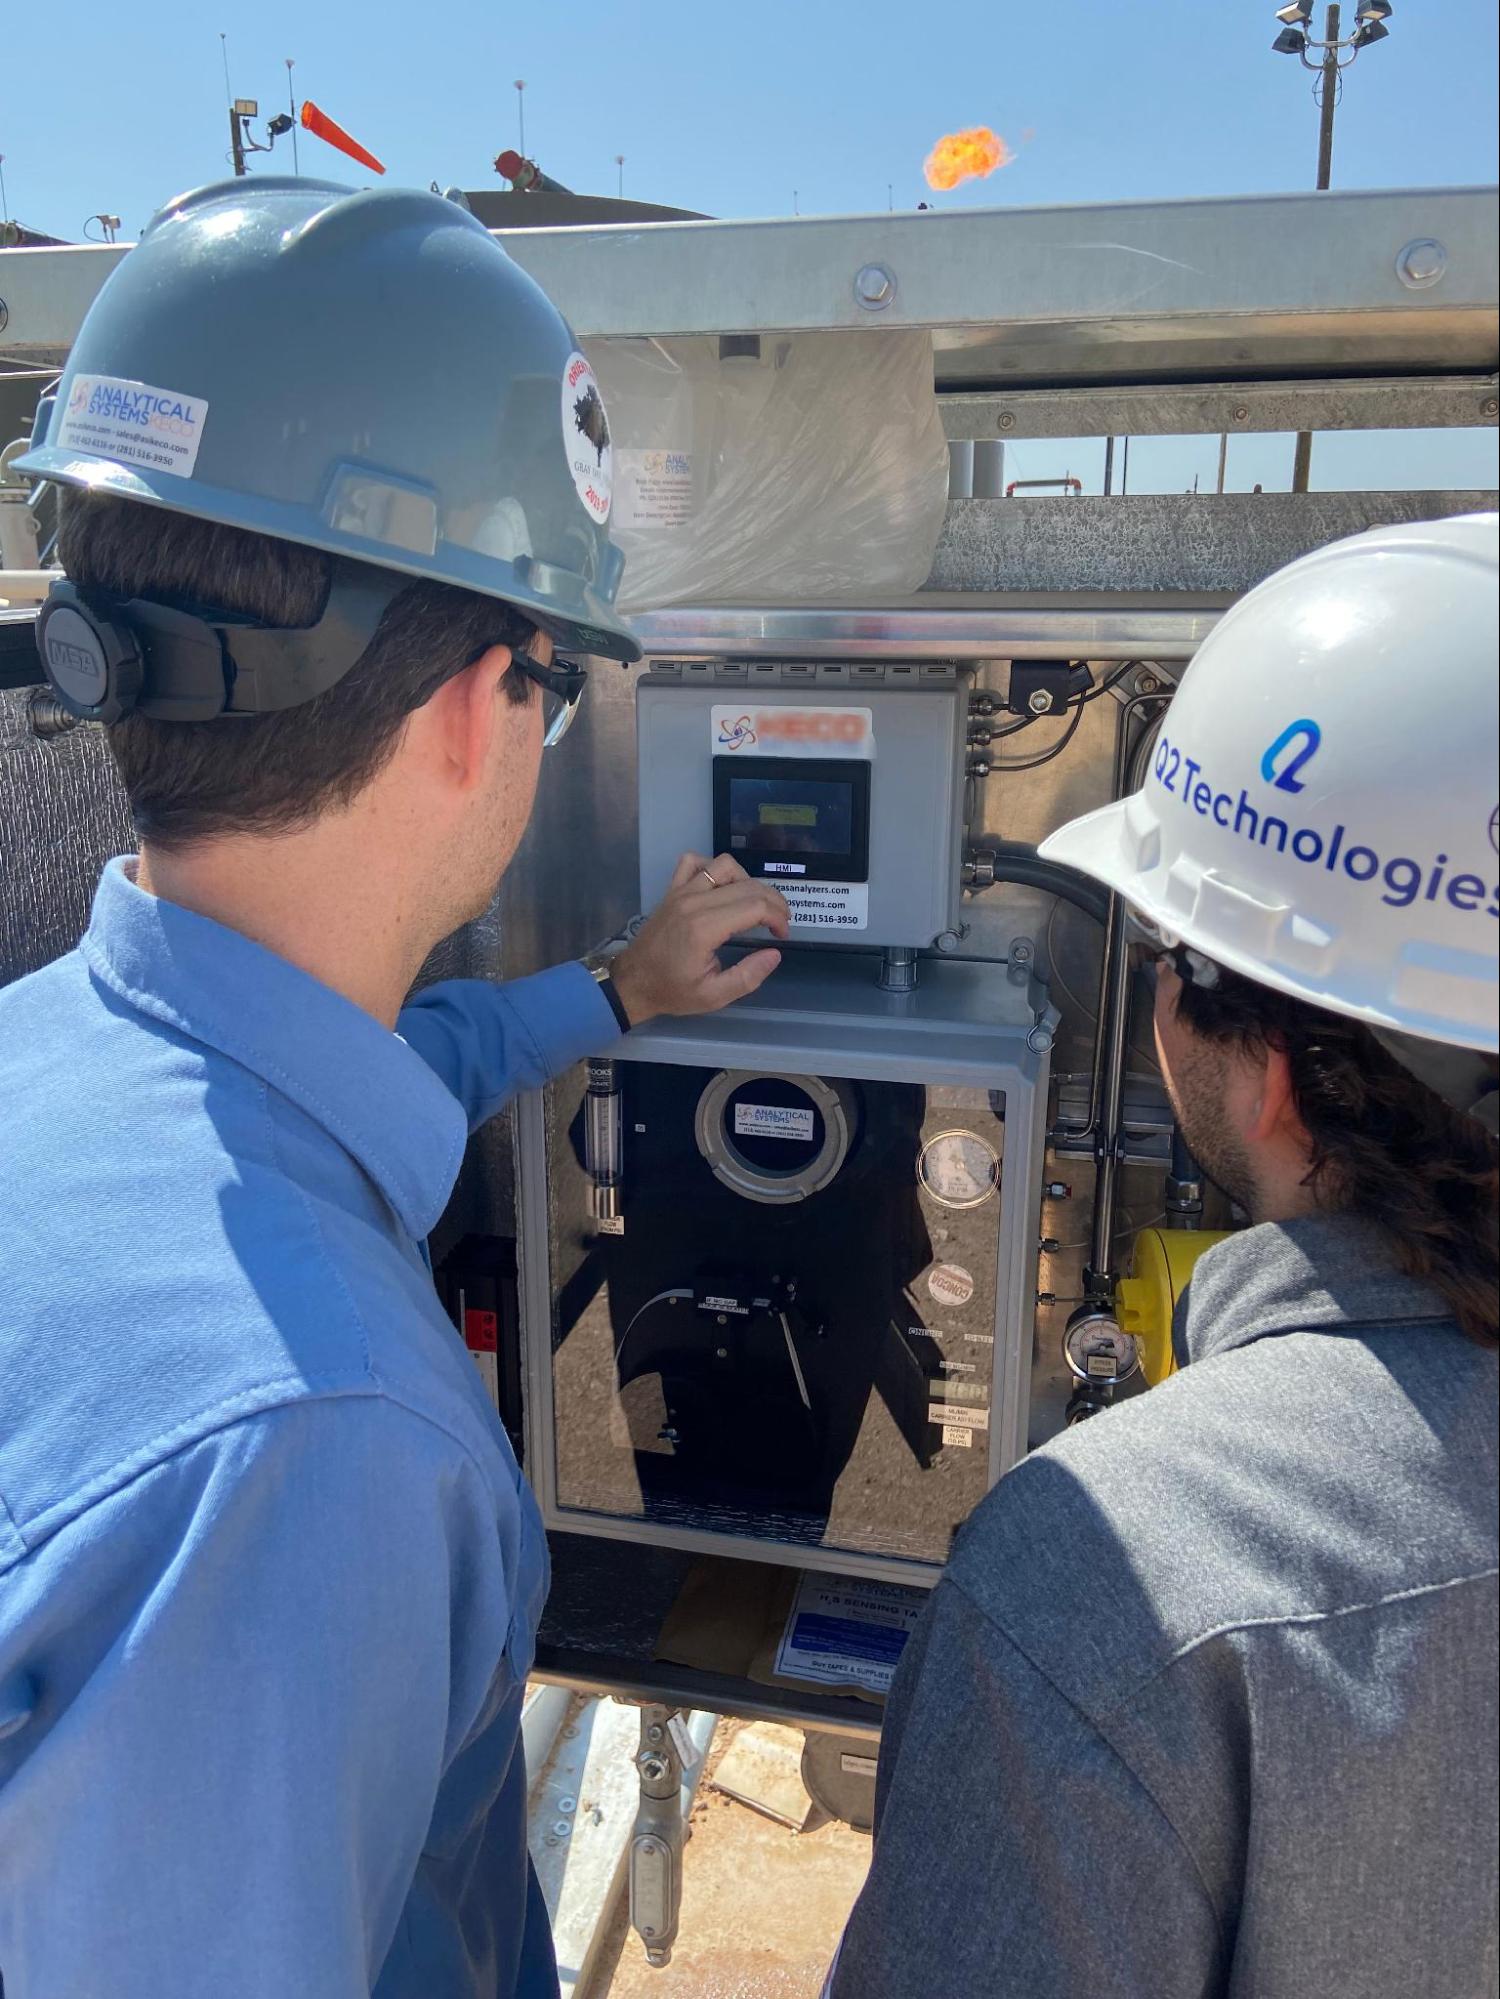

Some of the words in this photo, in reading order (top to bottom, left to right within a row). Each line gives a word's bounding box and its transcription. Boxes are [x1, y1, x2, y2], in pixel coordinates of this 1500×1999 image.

[92, 384, 195, 424] ANALYTICAL
[88, 400, 150, 426] SYSTEMS
[150, 413, 195, 438] KECO
[116, 429, 189, 455] sales@asikeco.com
[116, 444, 136, 458] (281)
[136, 447, 173, 467] 516-3950
[574, 460, 592, 476] GRAY
[775, 864, 792, 873] HMI
[787, 898, 846, 911] osystems.com
[794, 912, 817, 924] (281)
[818, 914, 858, 925] 516-3950
[754, 1108, 809, 1121] ANALYTICAL
[754, 1114, 790, 1124] SYSTEMS
[931, 1271, 969, 1300] CONCOA
[843, 1598, 900, 1615] SENSING
[856, 1667, 889, 1680] SUPPLIES
